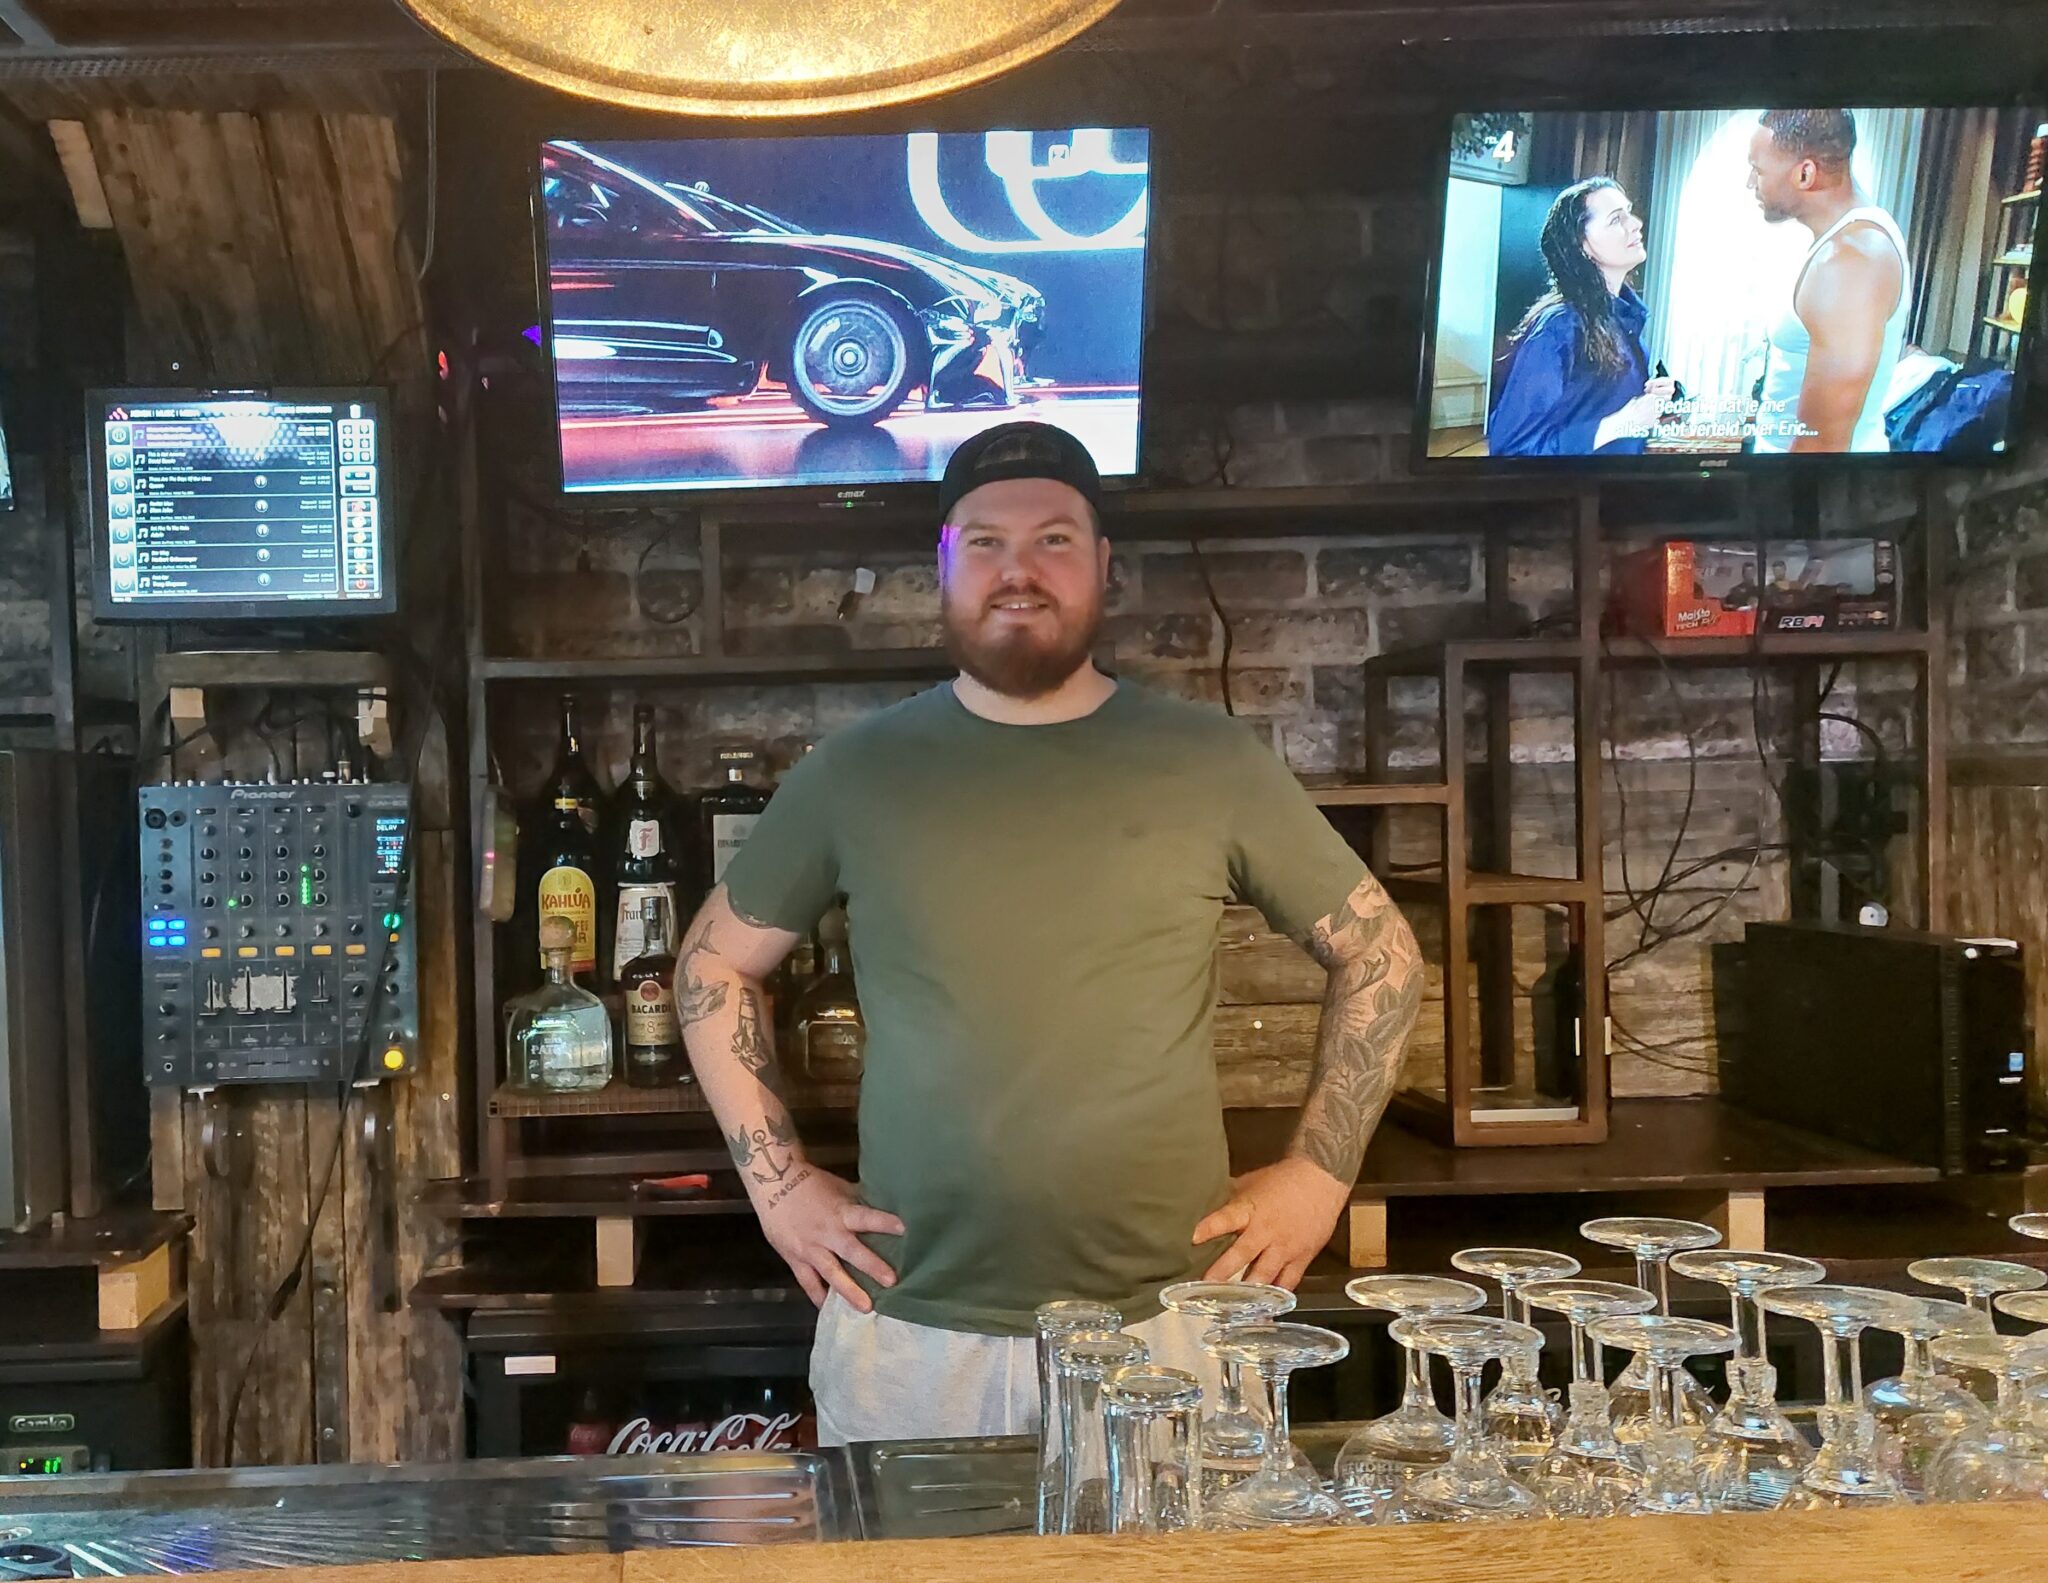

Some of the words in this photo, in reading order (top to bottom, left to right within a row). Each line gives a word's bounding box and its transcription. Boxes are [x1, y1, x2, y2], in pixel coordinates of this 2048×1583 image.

[1492, 130, 1515, 162] 4
[1652, 420, 1687, 437] hebt
[1688, 419, 1740, 437] verteld
[1742, 421, 1776, 437] over
[1678, 608, 1711, 622] Maisto
[230, 789, 296, 800] Pioneer
[376, 824, 398, 832] DELAY
[646, 1020, 656, 1034] 8
[605, 1412, 803, 1455] Coca-Cl
